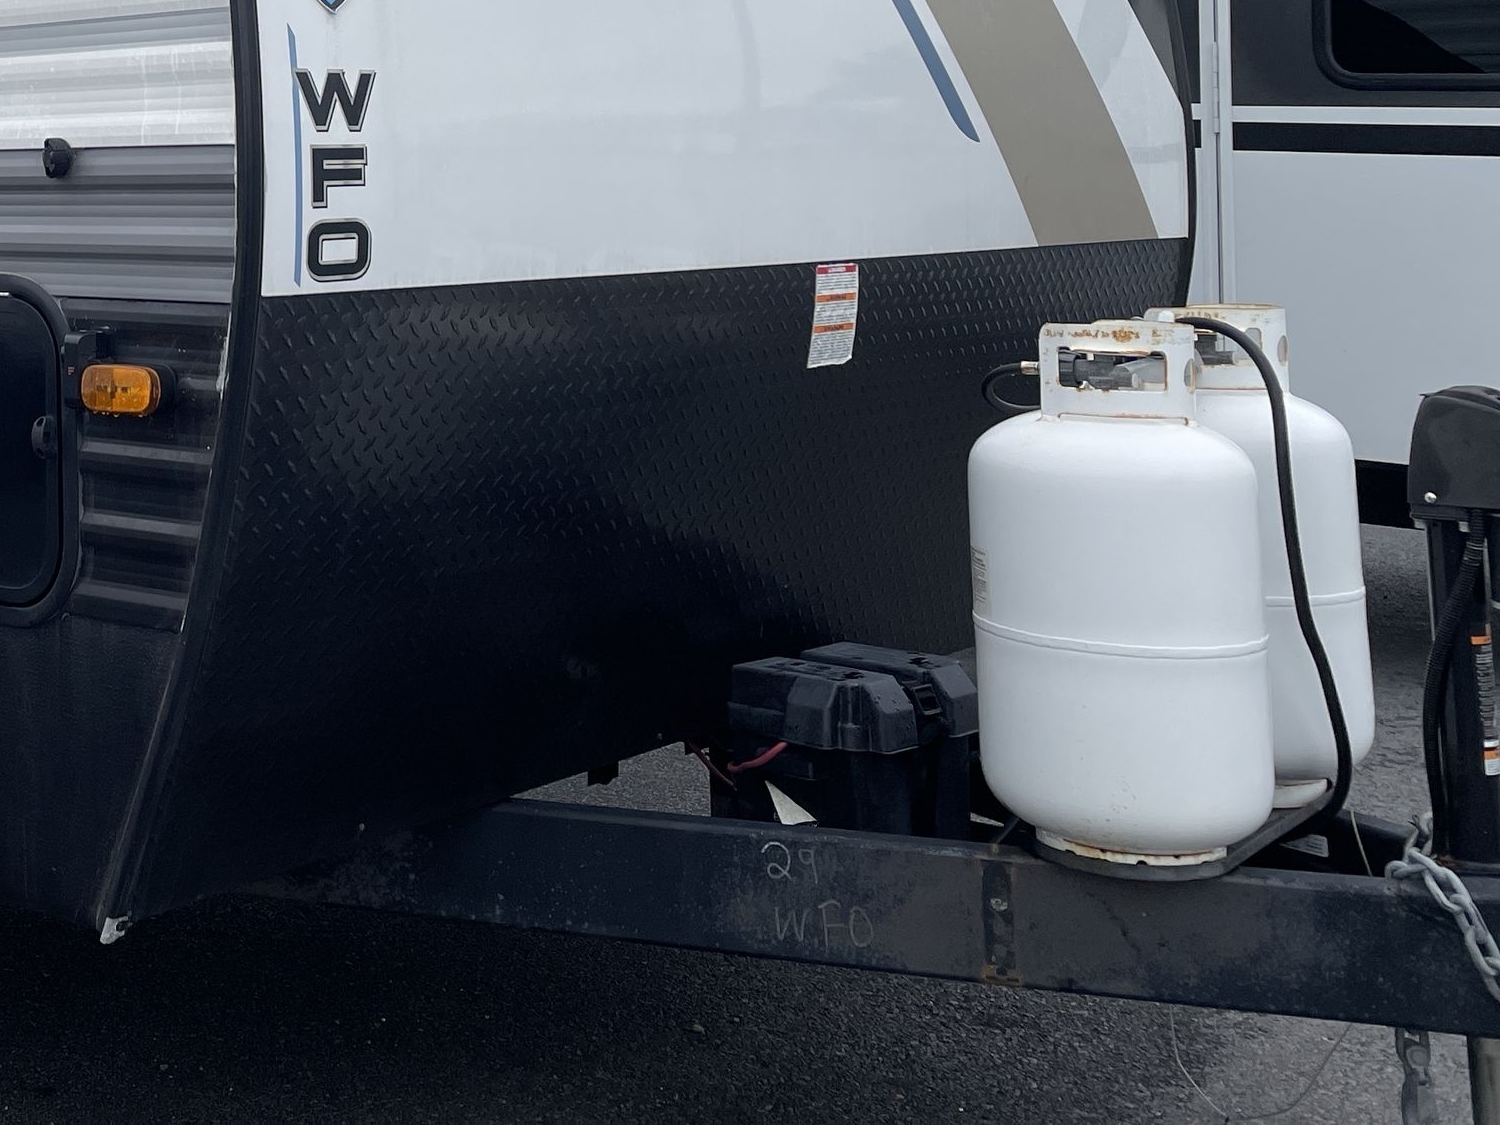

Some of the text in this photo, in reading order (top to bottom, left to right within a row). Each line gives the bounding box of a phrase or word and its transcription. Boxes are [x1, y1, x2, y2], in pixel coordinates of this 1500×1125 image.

[292, 68, 377, 283] WFO
[761, 841, 819, 885] 29
[774, 899, 874, 952] WFO
